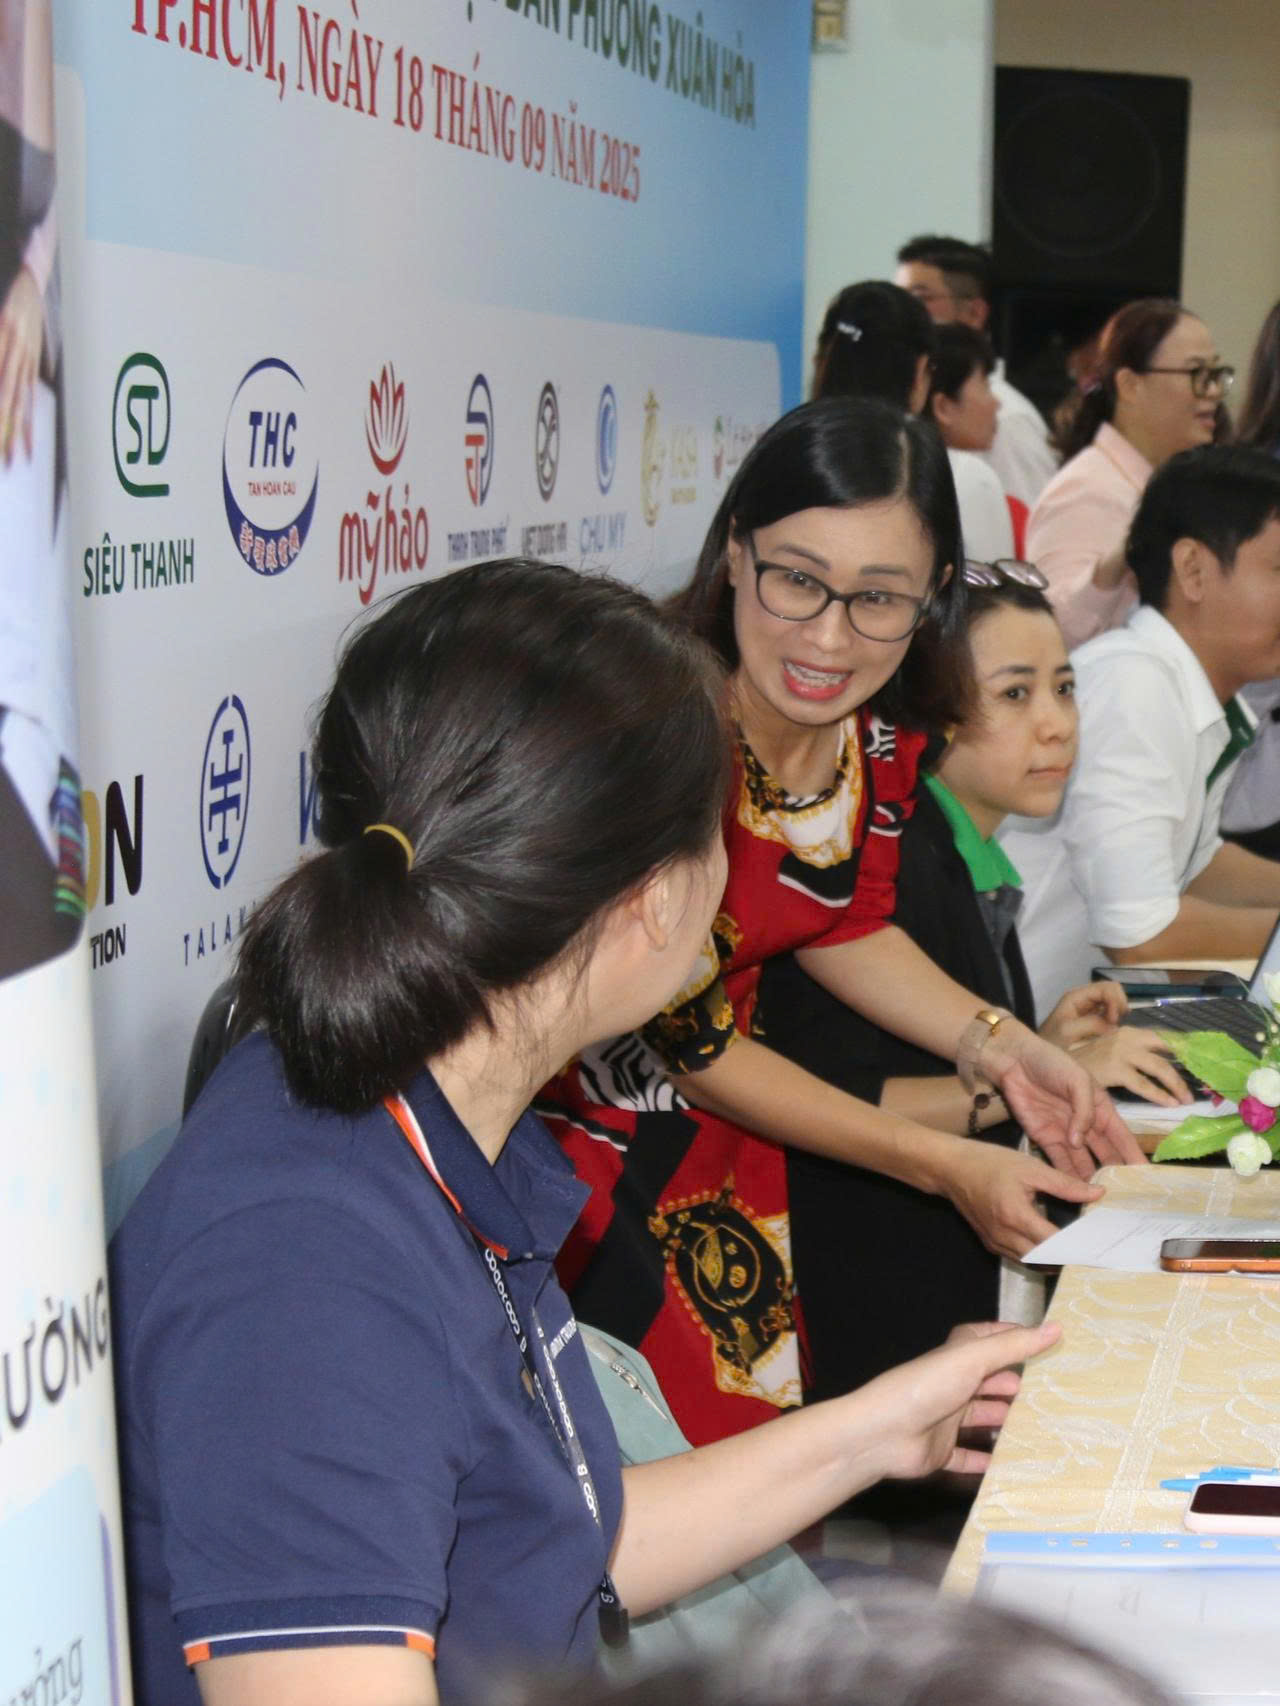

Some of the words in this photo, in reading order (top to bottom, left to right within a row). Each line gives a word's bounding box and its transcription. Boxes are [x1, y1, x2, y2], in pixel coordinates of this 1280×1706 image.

[297, 0, 383, 117] NGÀY
[393, 46, 425, 133] 18
[432, 51, 517, 163] THÁNG
[521, 101, 547, 173] 09
[551, 99, 597, 190] NĂM
[599, 133, 641, 203] 2025
[248, 411, 298, 468] THC
[83, 532, 126, 598] SIÊU
[130, 538, 195, 591] THANH
[0, 1277, 109, 1442] ƯỜNG
